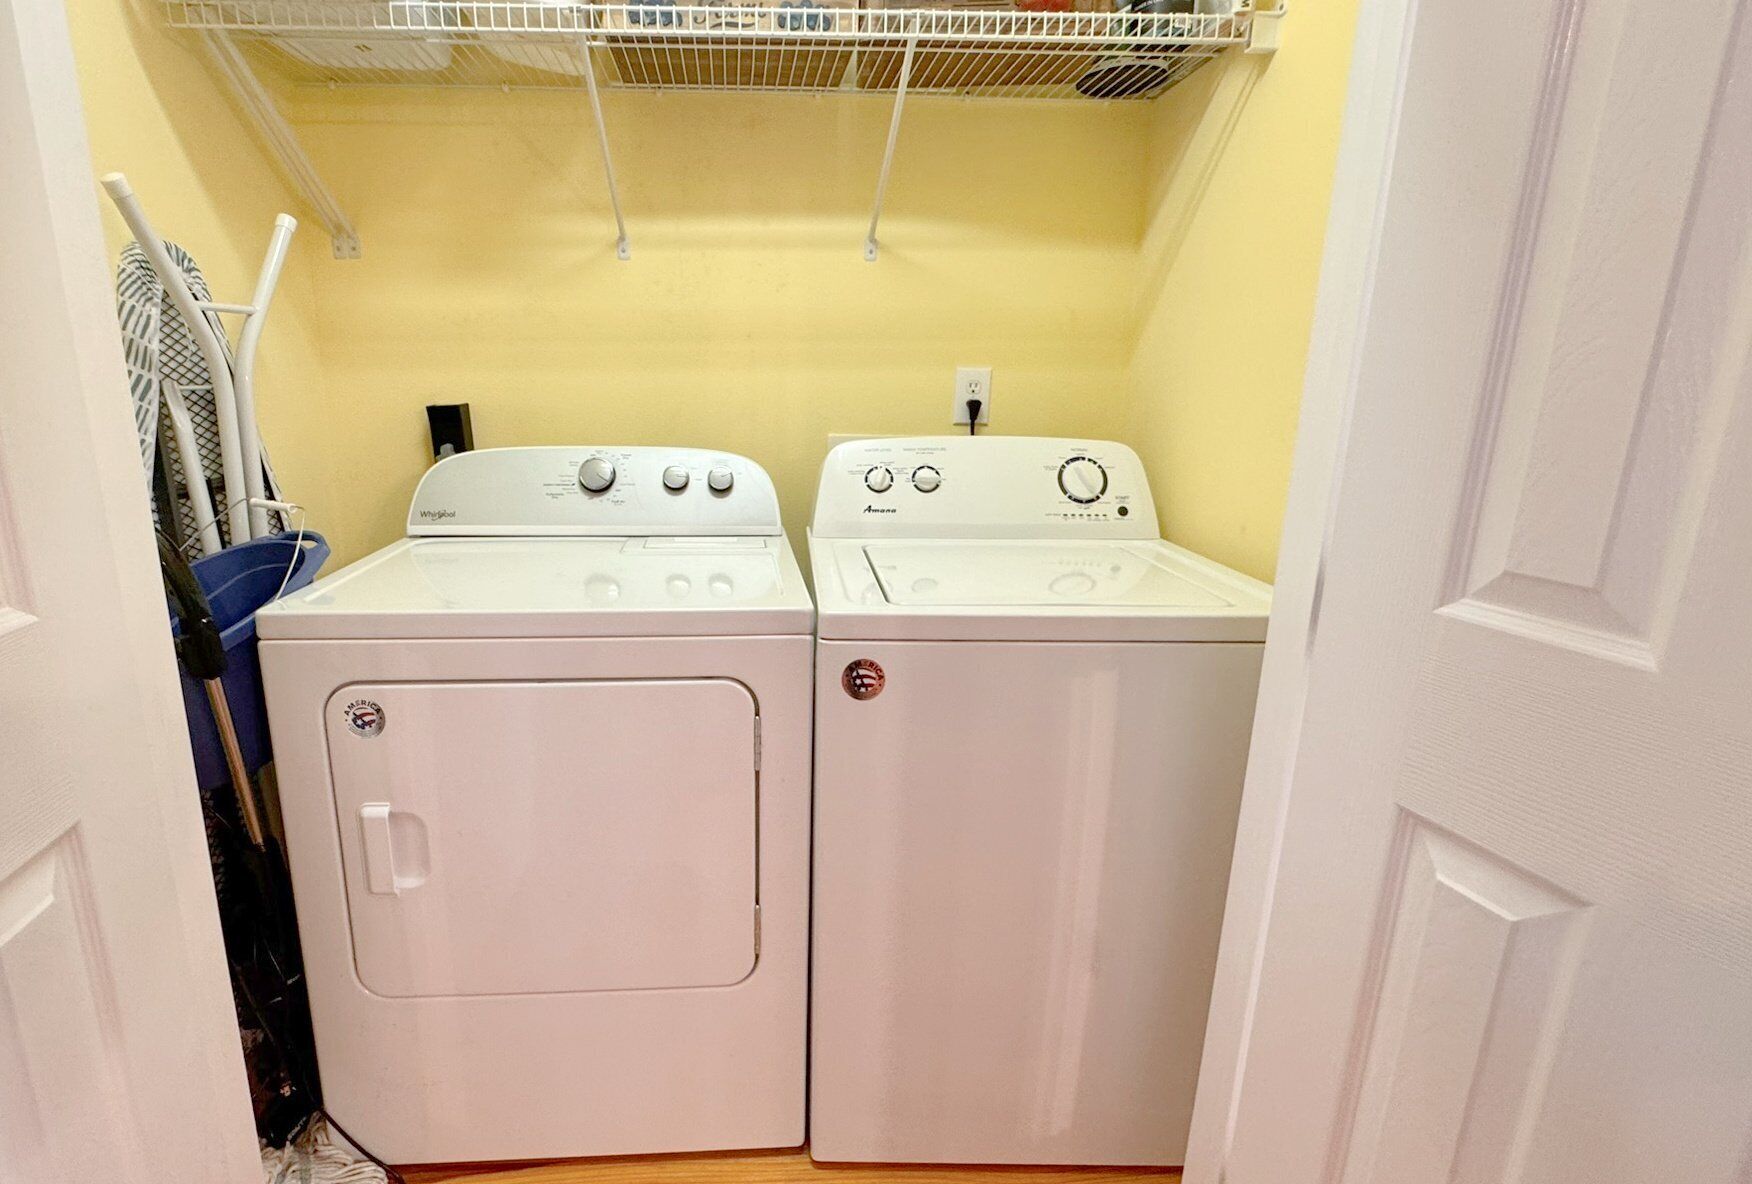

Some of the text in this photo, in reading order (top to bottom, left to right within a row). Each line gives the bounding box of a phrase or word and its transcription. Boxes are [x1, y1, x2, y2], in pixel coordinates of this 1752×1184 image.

[420, 509, 456, 521] Whirlpool
[863, 505, 897, 514] Amana
[344, 700, 381, 716] AMERICA
